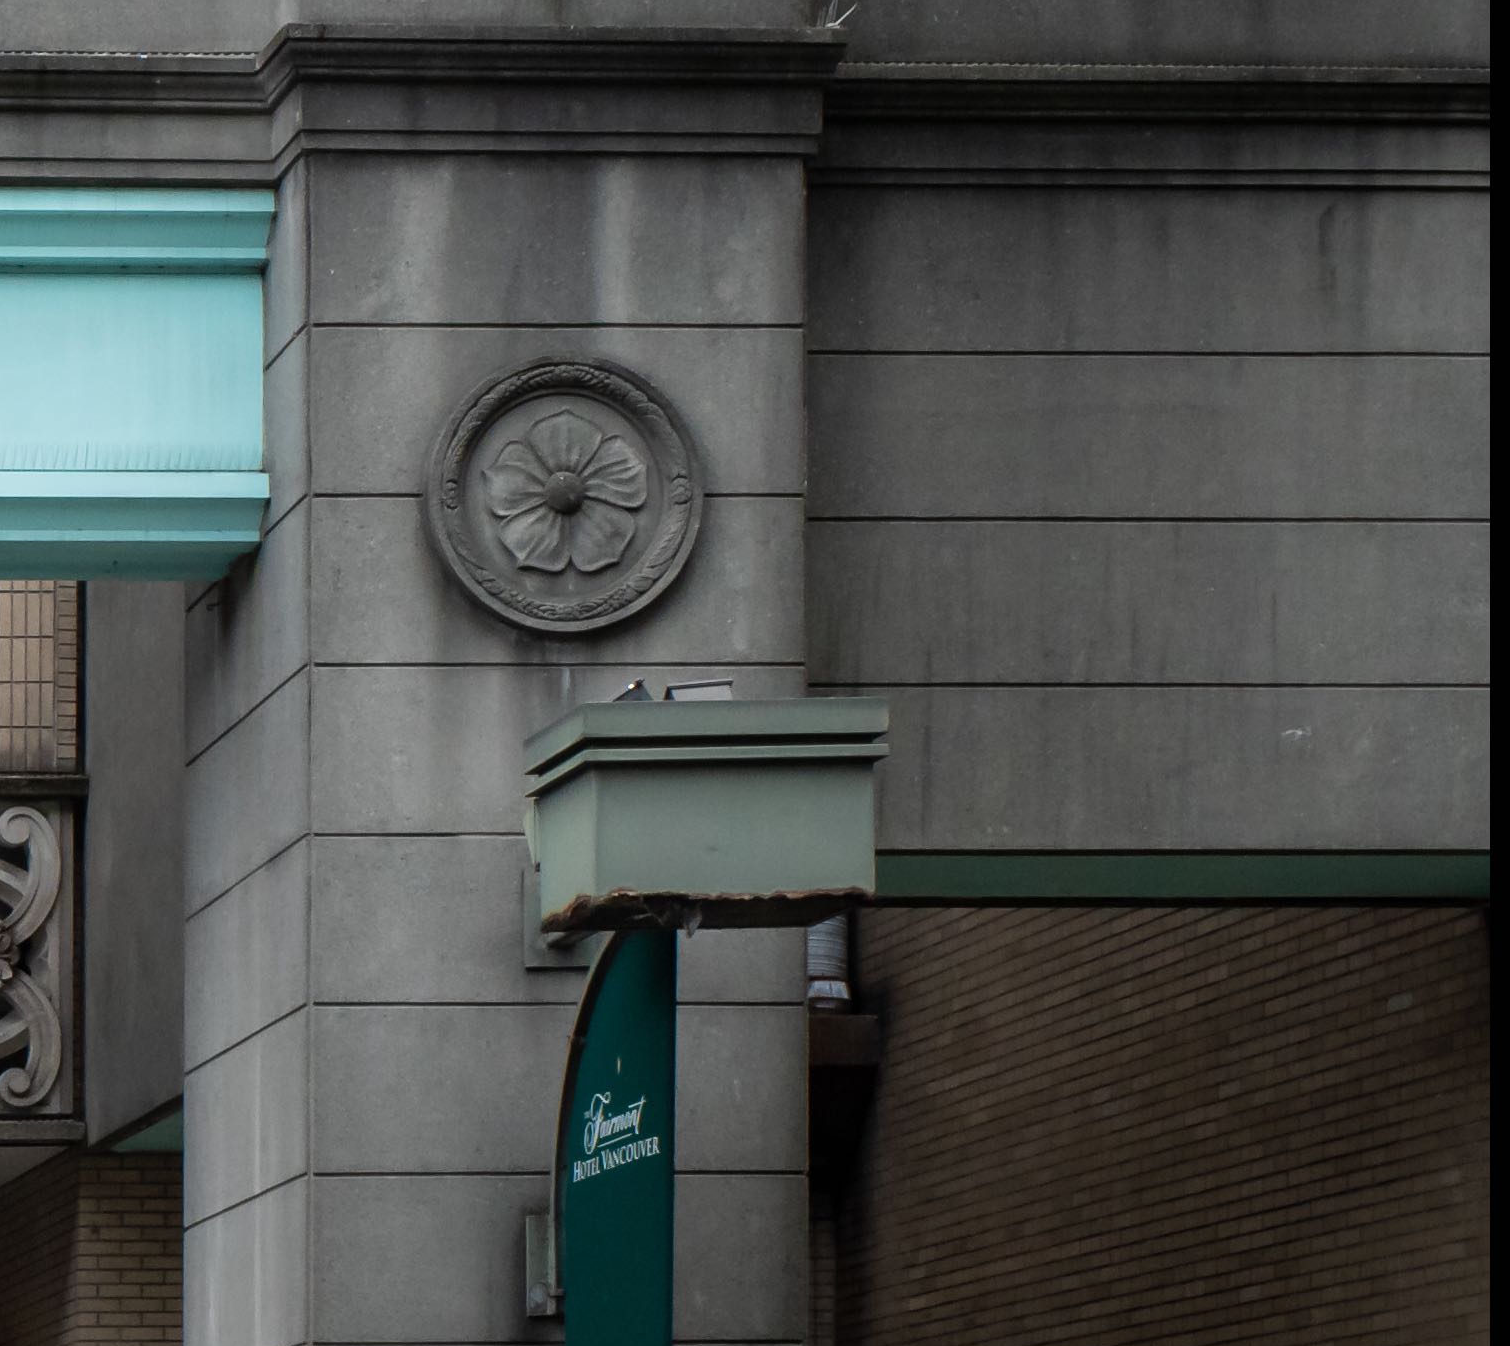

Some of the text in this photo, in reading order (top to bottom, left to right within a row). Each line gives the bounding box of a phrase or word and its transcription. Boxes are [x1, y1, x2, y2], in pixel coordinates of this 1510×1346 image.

[584, 1091, 647, 1155] Fairmont
[573, 1137, 661, 1183] HOTEL VANCOUVER
